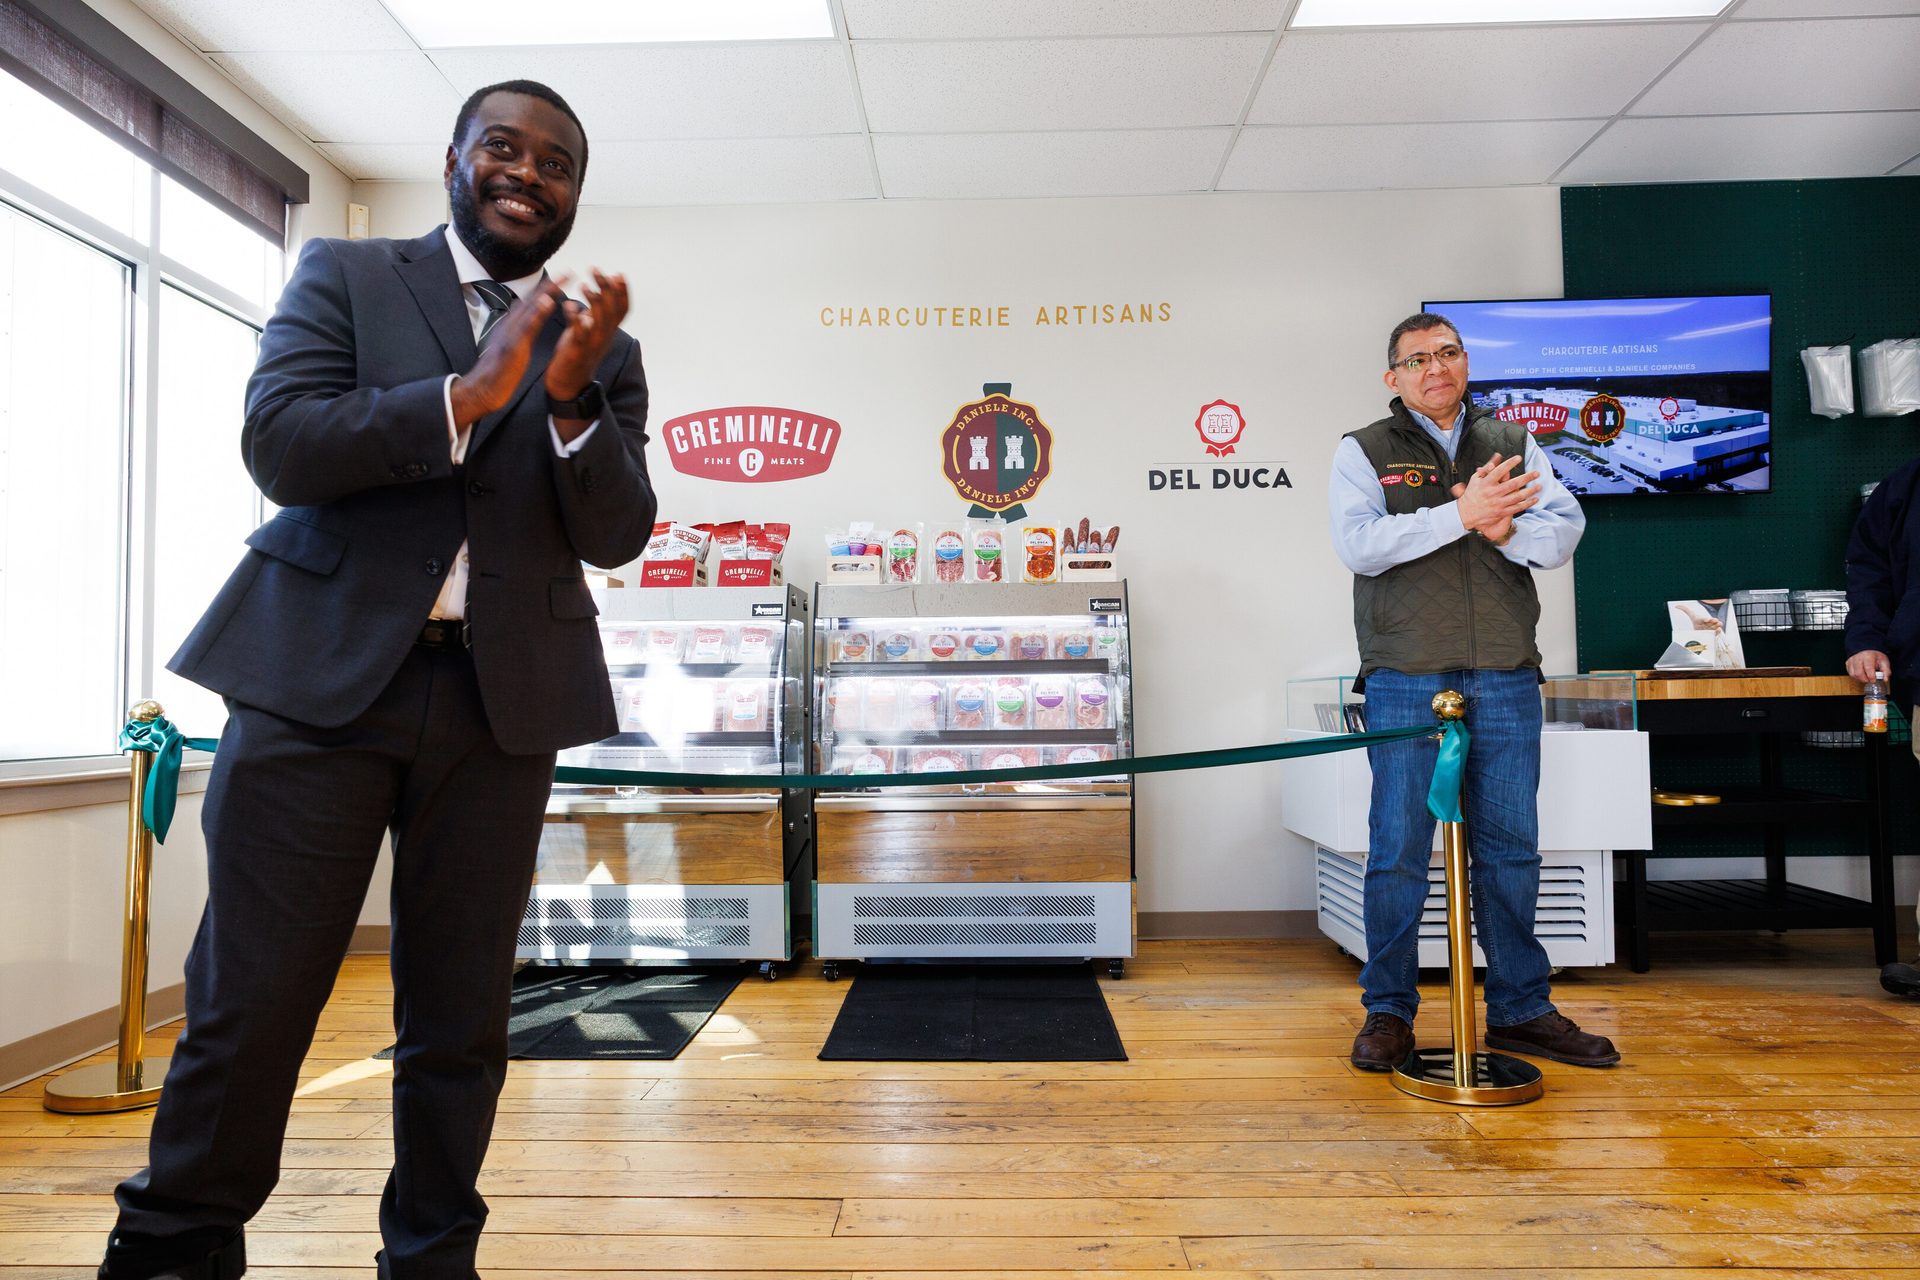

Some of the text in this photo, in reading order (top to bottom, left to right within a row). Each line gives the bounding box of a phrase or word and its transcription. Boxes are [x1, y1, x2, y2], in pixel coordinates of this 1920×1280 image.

[820, 302, 1172, 327] CHARCUTERIE ARTISANS
[1541, 344, 1658, 357] CHARCUTERIE ARTISANS
[1504, 367, 1527, 375] HOME
[1559, 366, 1606, 374] CREMINELLI
[1650, 363, 1696, 371] COMPANIES
[956, 403, 1035, 431] DANIELE INC.
[1499, 406, 1567, 423] CREMINELLI
[671, 414, 834, 455] CREMINELLI
[1639, 424, 1700, 434] DEL DUCA
[704, 457, 731, 465] FINE
[746, 452, 756, 471] C
[770, 457, 805, 465] MEATS
[1148, 467, 1293, 490] DEL DUCA
[956, 477, 1039, 503] DANIELE INC.
